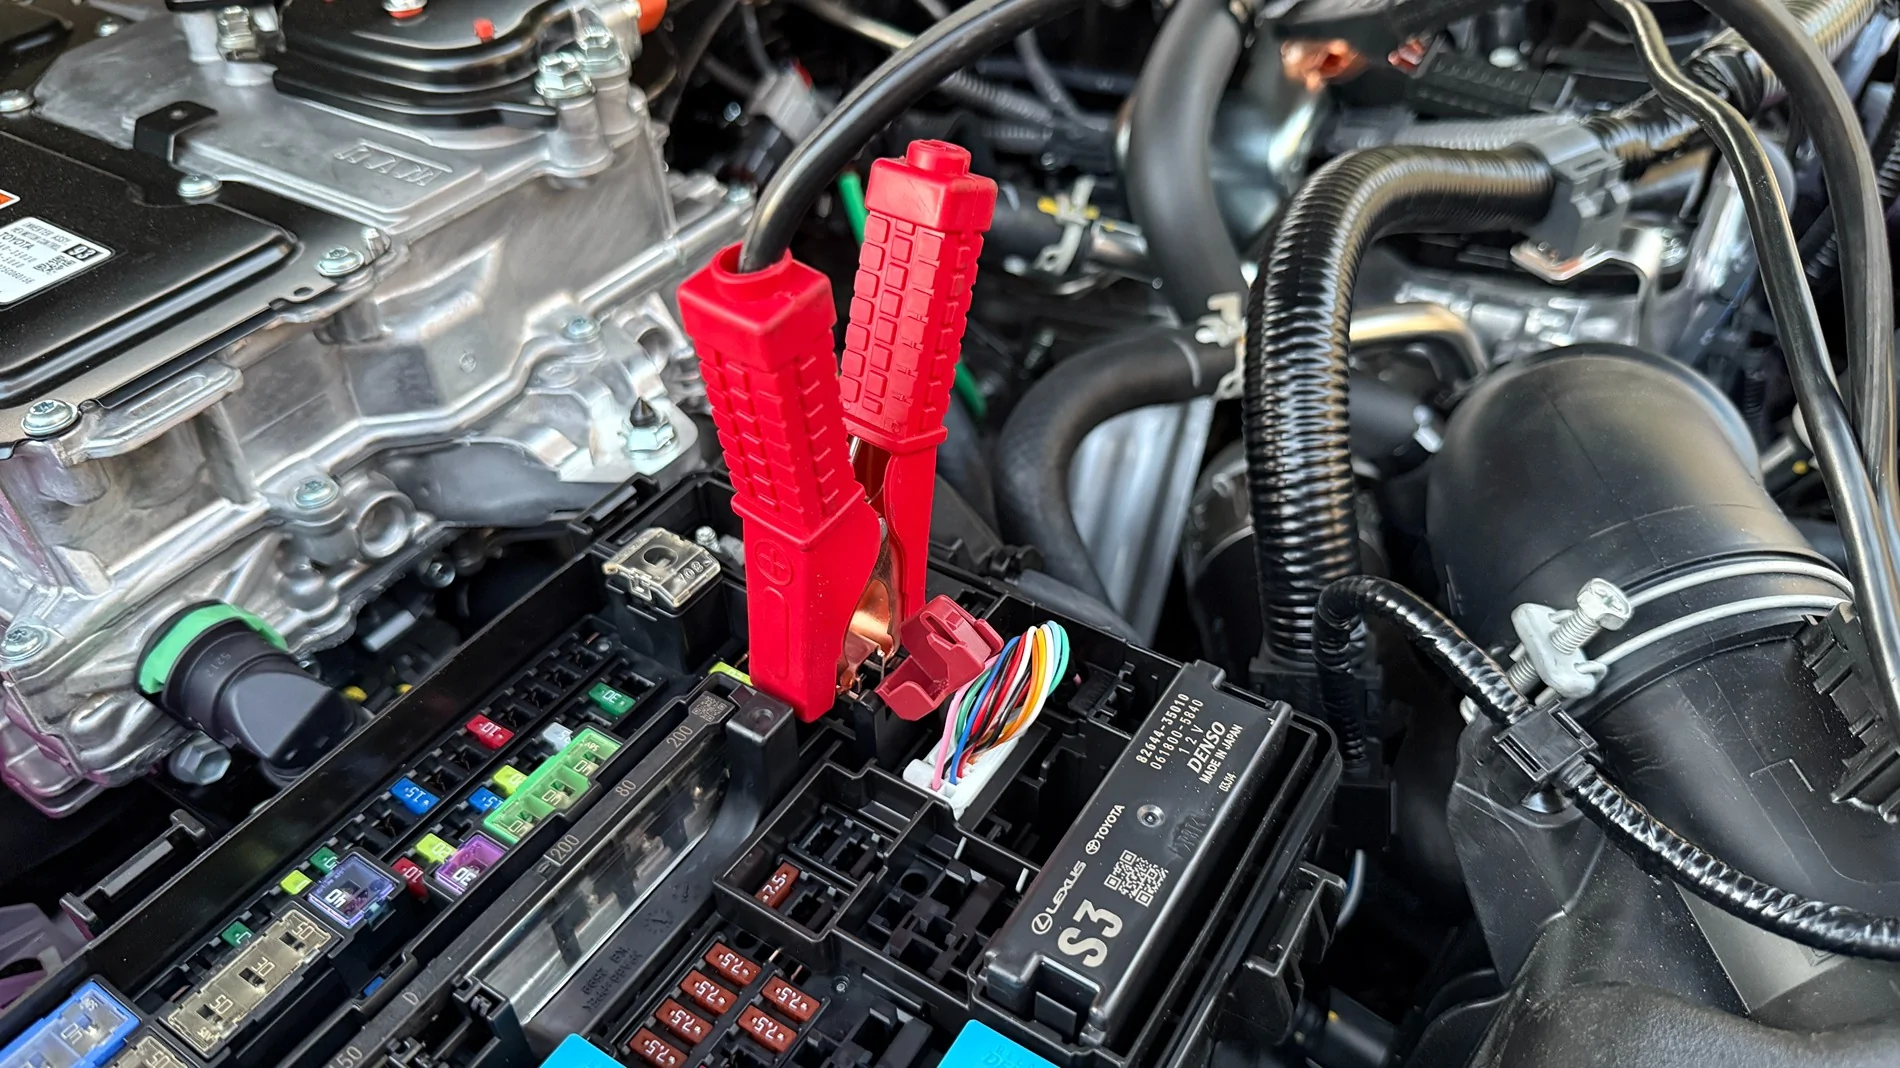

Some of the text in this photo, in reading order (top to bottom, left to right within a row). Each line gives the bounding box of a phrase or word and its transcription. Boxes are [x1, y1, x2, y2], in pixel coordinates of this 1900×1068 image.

[1, 232, 35, 250] TOYOTA
[67, 245, 98, 262] 93
[602, 689, 621, 703] 30
[481, 722, 501, 737] 10
[666, 725, 693, 748] 200
[1136, 693, 1190, 764] 82644-35010
[1150, 699, 1204, 770] 061800-5840
[1186, 721, 1226, 774] DENSO
[1199, 724, 1244, 784] MADE IN JAPAN
[573, 760, 592, 776] 40
[407, 786, 425, 803] 15
[542, 789, 561, 806] 40
[615, 779, 637, 797] 80
[508, 821, 528, 837] 40
[1094, 804, 1125, 841] TOYOTA
[432, 842, 454, 859] 20
[550, 834, 580, 860] 200
[403, 866, 422, 883] 10
[453, 868, 477, 887] 30
[762, 875, 786, 896] 7.5
[1045, 860, 1087, 915] LEXUS
[324, 888, 348, 908] 40
[292, 921, 315, 940] 50
[1058, 899, 1123, 968] S3
[251, 957, 275, 977] 30
[721, 953, 744, 974] 7.5
[696, 981, 720, 1002] 7.5
[778, 987, 802, 1010] 7.5
[209, 994, 233, 1014] 50
[671, 1010, 696, 1032] 7.5
[753, 1016, 778, 1039] 7.5
[61, 1022, 82, 1044] 40
[329, 1045, 363, 1068] 50
[645, 1040, 670, 1063] 7.5
